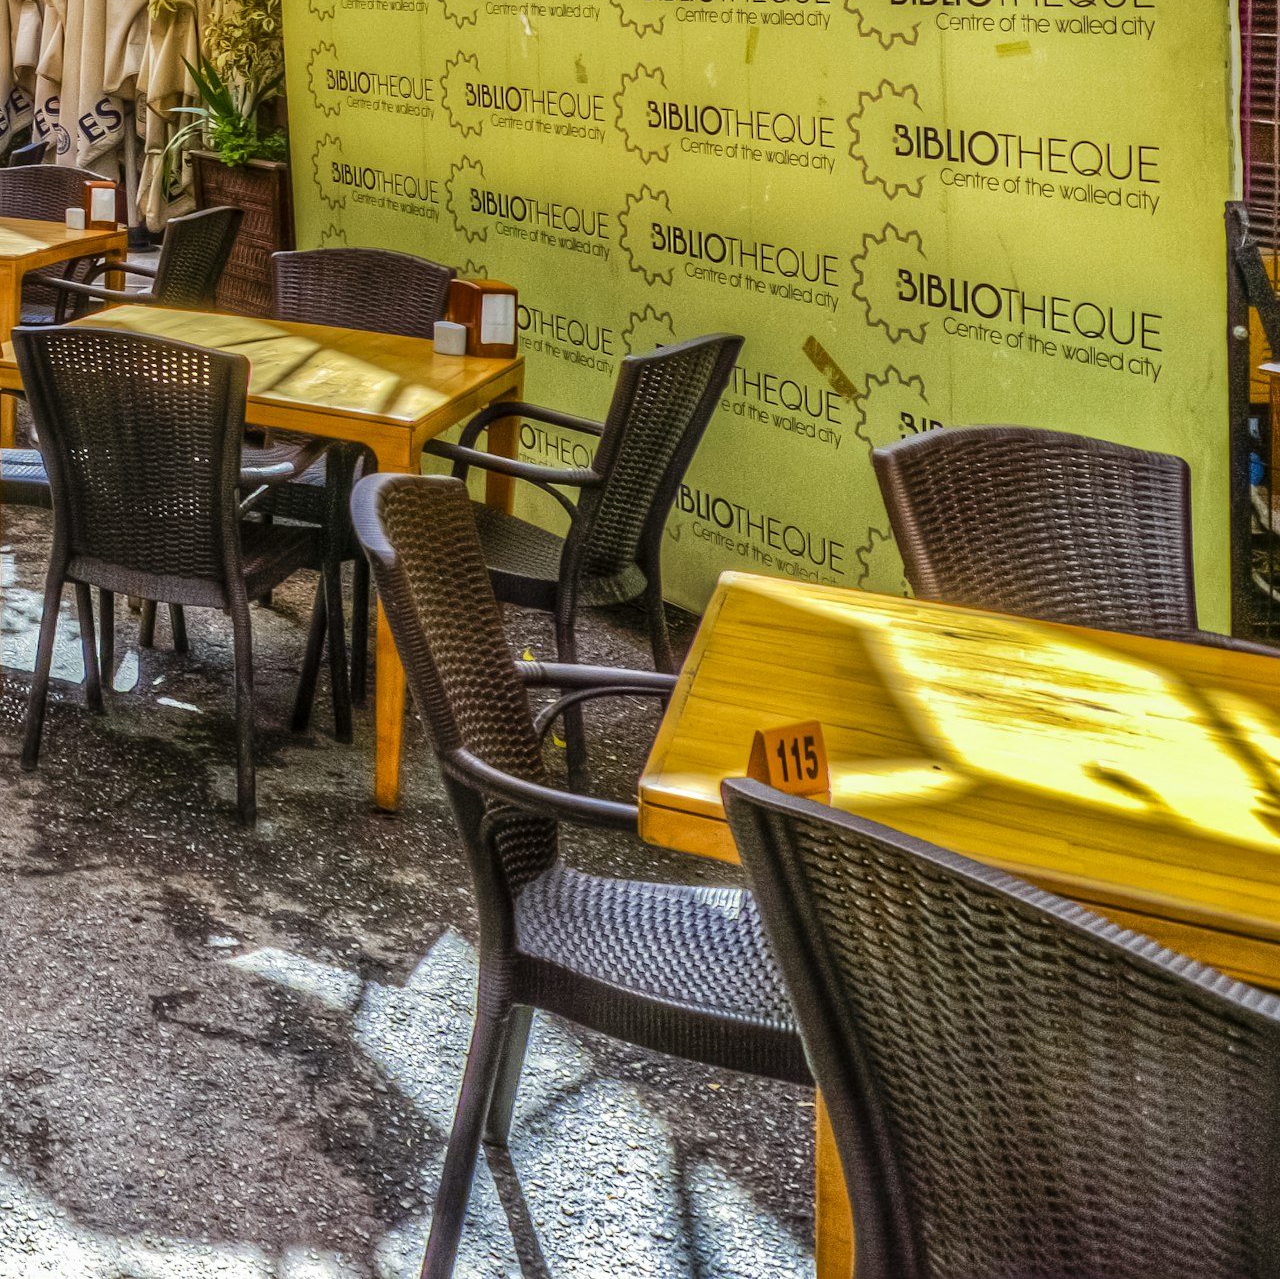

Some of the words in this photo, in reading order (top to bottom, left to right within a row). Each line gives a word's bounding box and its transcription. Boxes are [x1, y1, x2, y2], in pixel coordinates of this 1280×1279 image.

[486, 2, 518, 15] Centre
[519, 3, 528, 15] of
[531, 3, 546, 16] the
[548, 4, 581, 18] walled
[583, 5, 600, 21] city
[676, 7, 718, 23] Centre
[721, 8, 733, 23] of
[736, 9, 757, 24] the
[761, 10, 804, 25] walled
[803, 11, 830, 30] city
[936, 12, 995, 31] Centre
[999, 14, 1016, 32] of
[1021, 15, 1050, 33] the
[1055, 16, 1117, 35] walled
[1121, 16, 1155, 40] city
[327, 69, 434, 101] BIBLIOTHEQUE
[466, 83, 605, 121] BIBLIOTHEQUE
[491, 114, 523, 129] Centre
[525, 119, 534, 131] of
[536, 120, 551, 133] the
[555, 123, 586, 138] walled
[588, 127, 605, 143] city
[648, 101, 834, 148] BIBLIOTHEQUE
[681, 137, 723, 156] Centre
[726, 143, 738, 157] of
[741, 145, 762, 159] the
[766, 150, 809, 166] walled
[812, 155, 835, 173] city
[894, 124, 1158, 183] BIBLIOTHEQUE
[332, 163, 439, 203] BIBLIOTHEQUE
[940, 167, 999, 190] Centre
[1003, 176, 1020, 193] of
[1025, 178, 1054, 196] the
[1059, 184, 1121, 205] walled
[1126, 191, 1159, 214] city
[471, 188, 609, 239] BIBLIOTHEQUE
[496, 221, 528, 240] Centre
[530, 230, 538, 242] of
[540, 231, 556, 246] the
[558, 238, 591, 254] walled
[592, 244, 610, 261] city
[652, 223, 838, 287] BIBLIOTHEQUE
[685, 262, 727, 284] Centre
[730, 273, 742, 287] of
[745, 275, 766, 293] the
[769, 284, 812, 303] walled
[815, 292, 839, 311] city
[518, 304, 614, 356] OTHEQUE
[898, 269, 1161, 352] BIBLIOTHEQUE
[562, 349, 595, 369] walled
[943, 316, 1002, 344] Centre
[1007, 331, 1024, 349] of
[1028, 334, 1057, 356] the
[1062, 345, 1123, 370] walled
[1128, 357, 1162, 381] city
[733, 401, 746, 416] of
[748, 404, 769, 424] the
[772, 414, 816, 438] walled
[818, 427, 842, 450] city
[692, 521, 734, 551] Centre
[737, 541, 750, 557] of
[752, 545, 773, 567] the
[777, 736, 818, 782] 115
